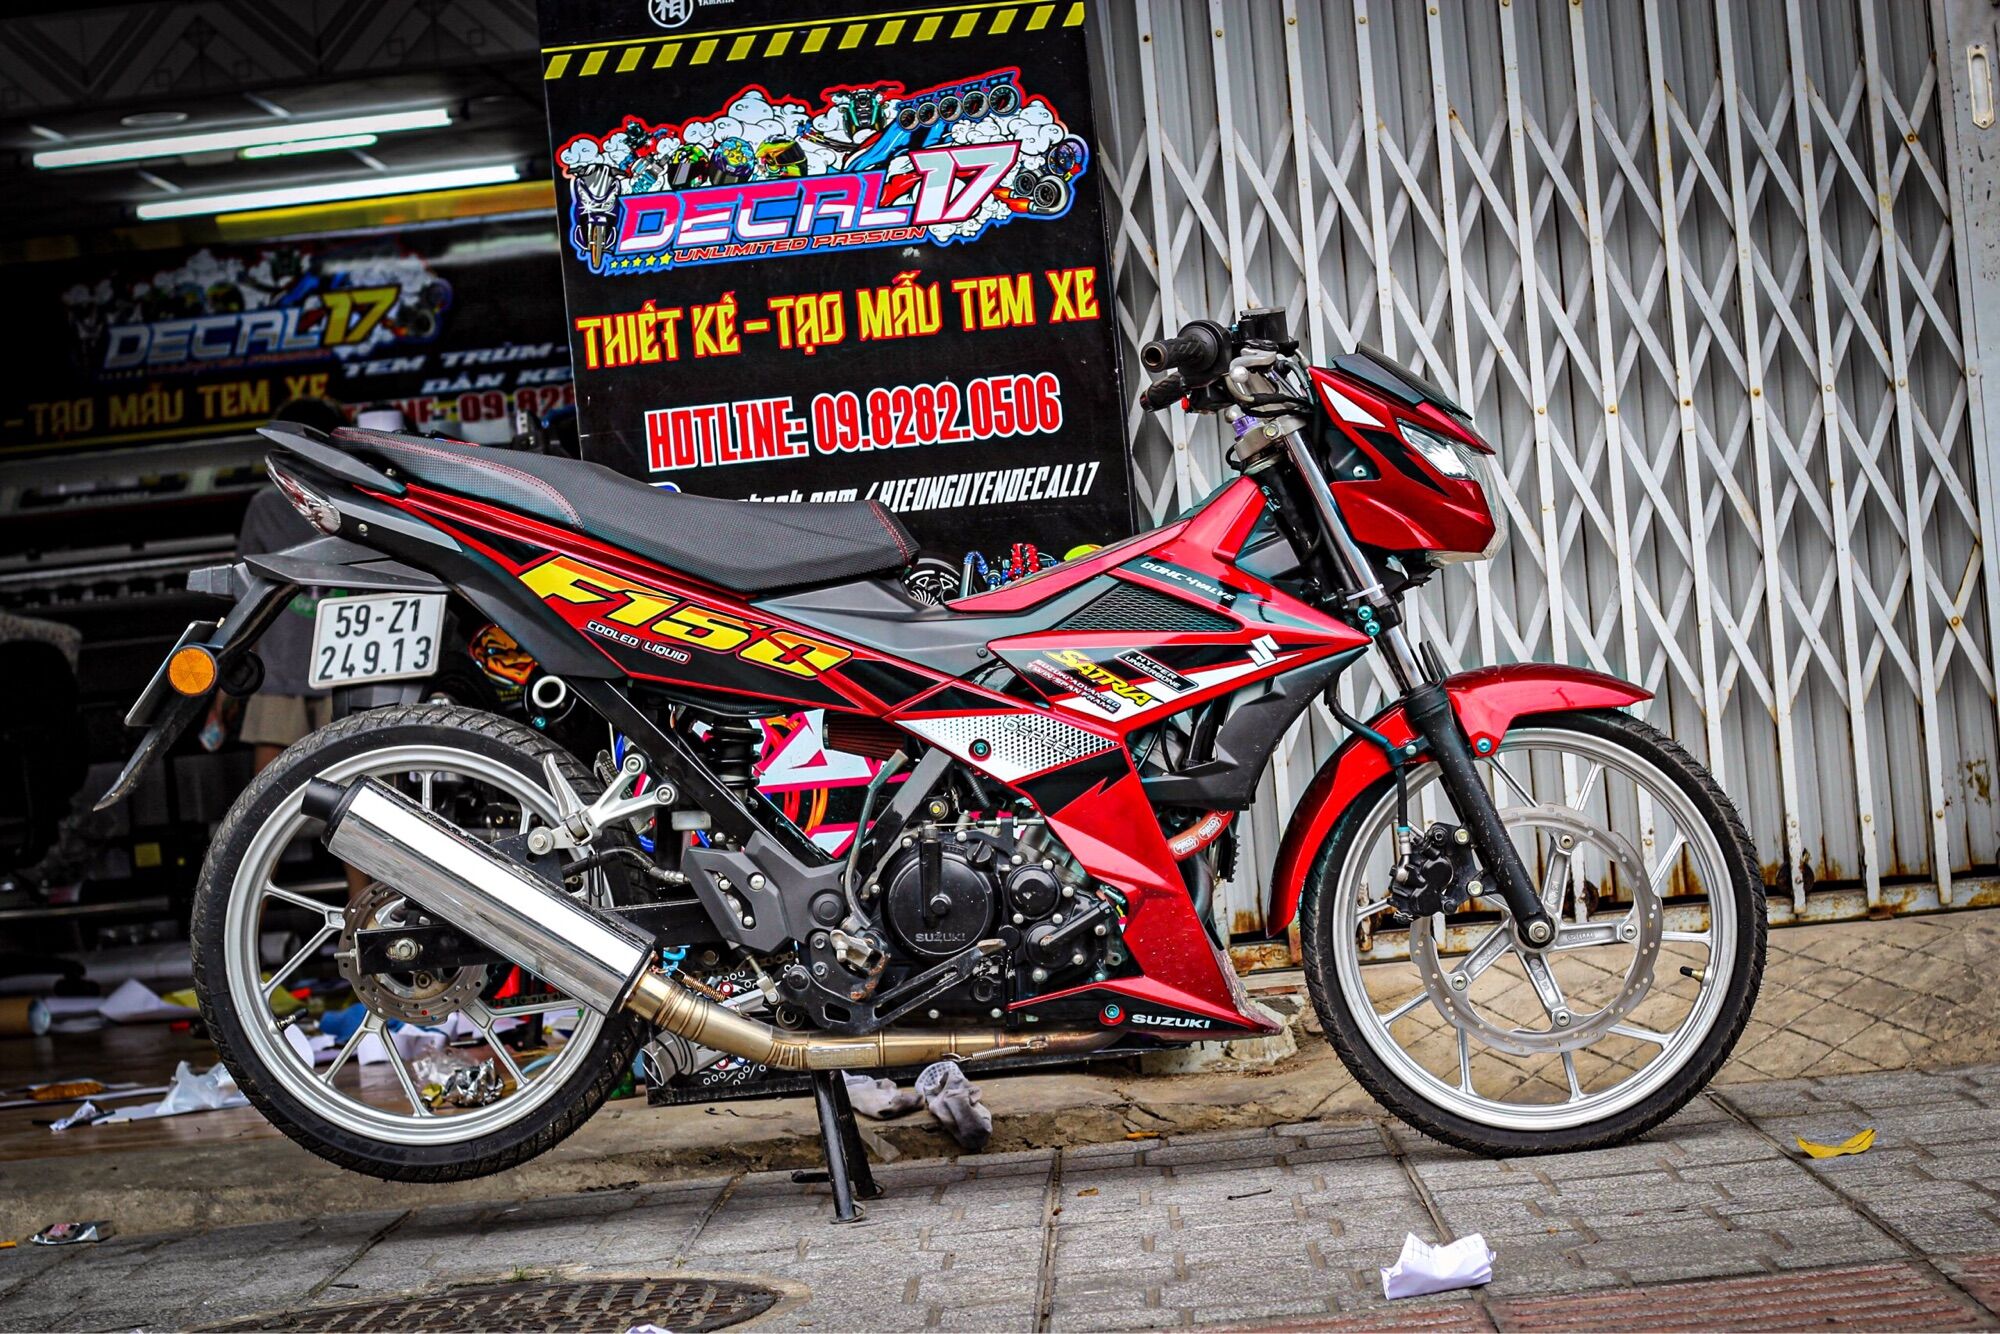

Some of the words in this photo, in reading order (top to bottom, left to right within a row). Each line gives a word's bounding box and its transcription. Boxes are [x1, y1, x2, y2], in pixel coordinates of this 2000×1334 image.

[617, 173, 908, 251] DECAL
[909, 142, 1018, 224] 17
[674, 237, 807, 262] UNLIMITED
[811, 226, 926, 248] PASSION
[105, 310, 321, 367] DECAL
[323, 286, 398, 346] 17
[576, 299, 683, 369] THIẾT
[951, 272, 1036, 332] TEM
[1045, 266, 1100, 325] XE
[197, 379, 271, 420] TEM
[645, 396, 810, 472] HOTLINE:
[811, 371, 1064, 454] 09.8282.0506
[1140, 561, 1187, 581] DOHC
[335, 599, 421, 638] 59-Z1
[318, 636, 431, 680] 249.13
[586, 620, 640, 648] COOLED
[643, 638, 690, 663] LIQUID
[1042, 649, 1152, 707] SATRIA
[1125, 656, 1181, 689] UNDERBONE
[1136, 655, 1179, 680] HYPER
[1081, 692, 1119, 713] FRAME
[915, 931, 966, 942] SUZUKI
[1132, 1013, 1211, 1029] SUZUKI
